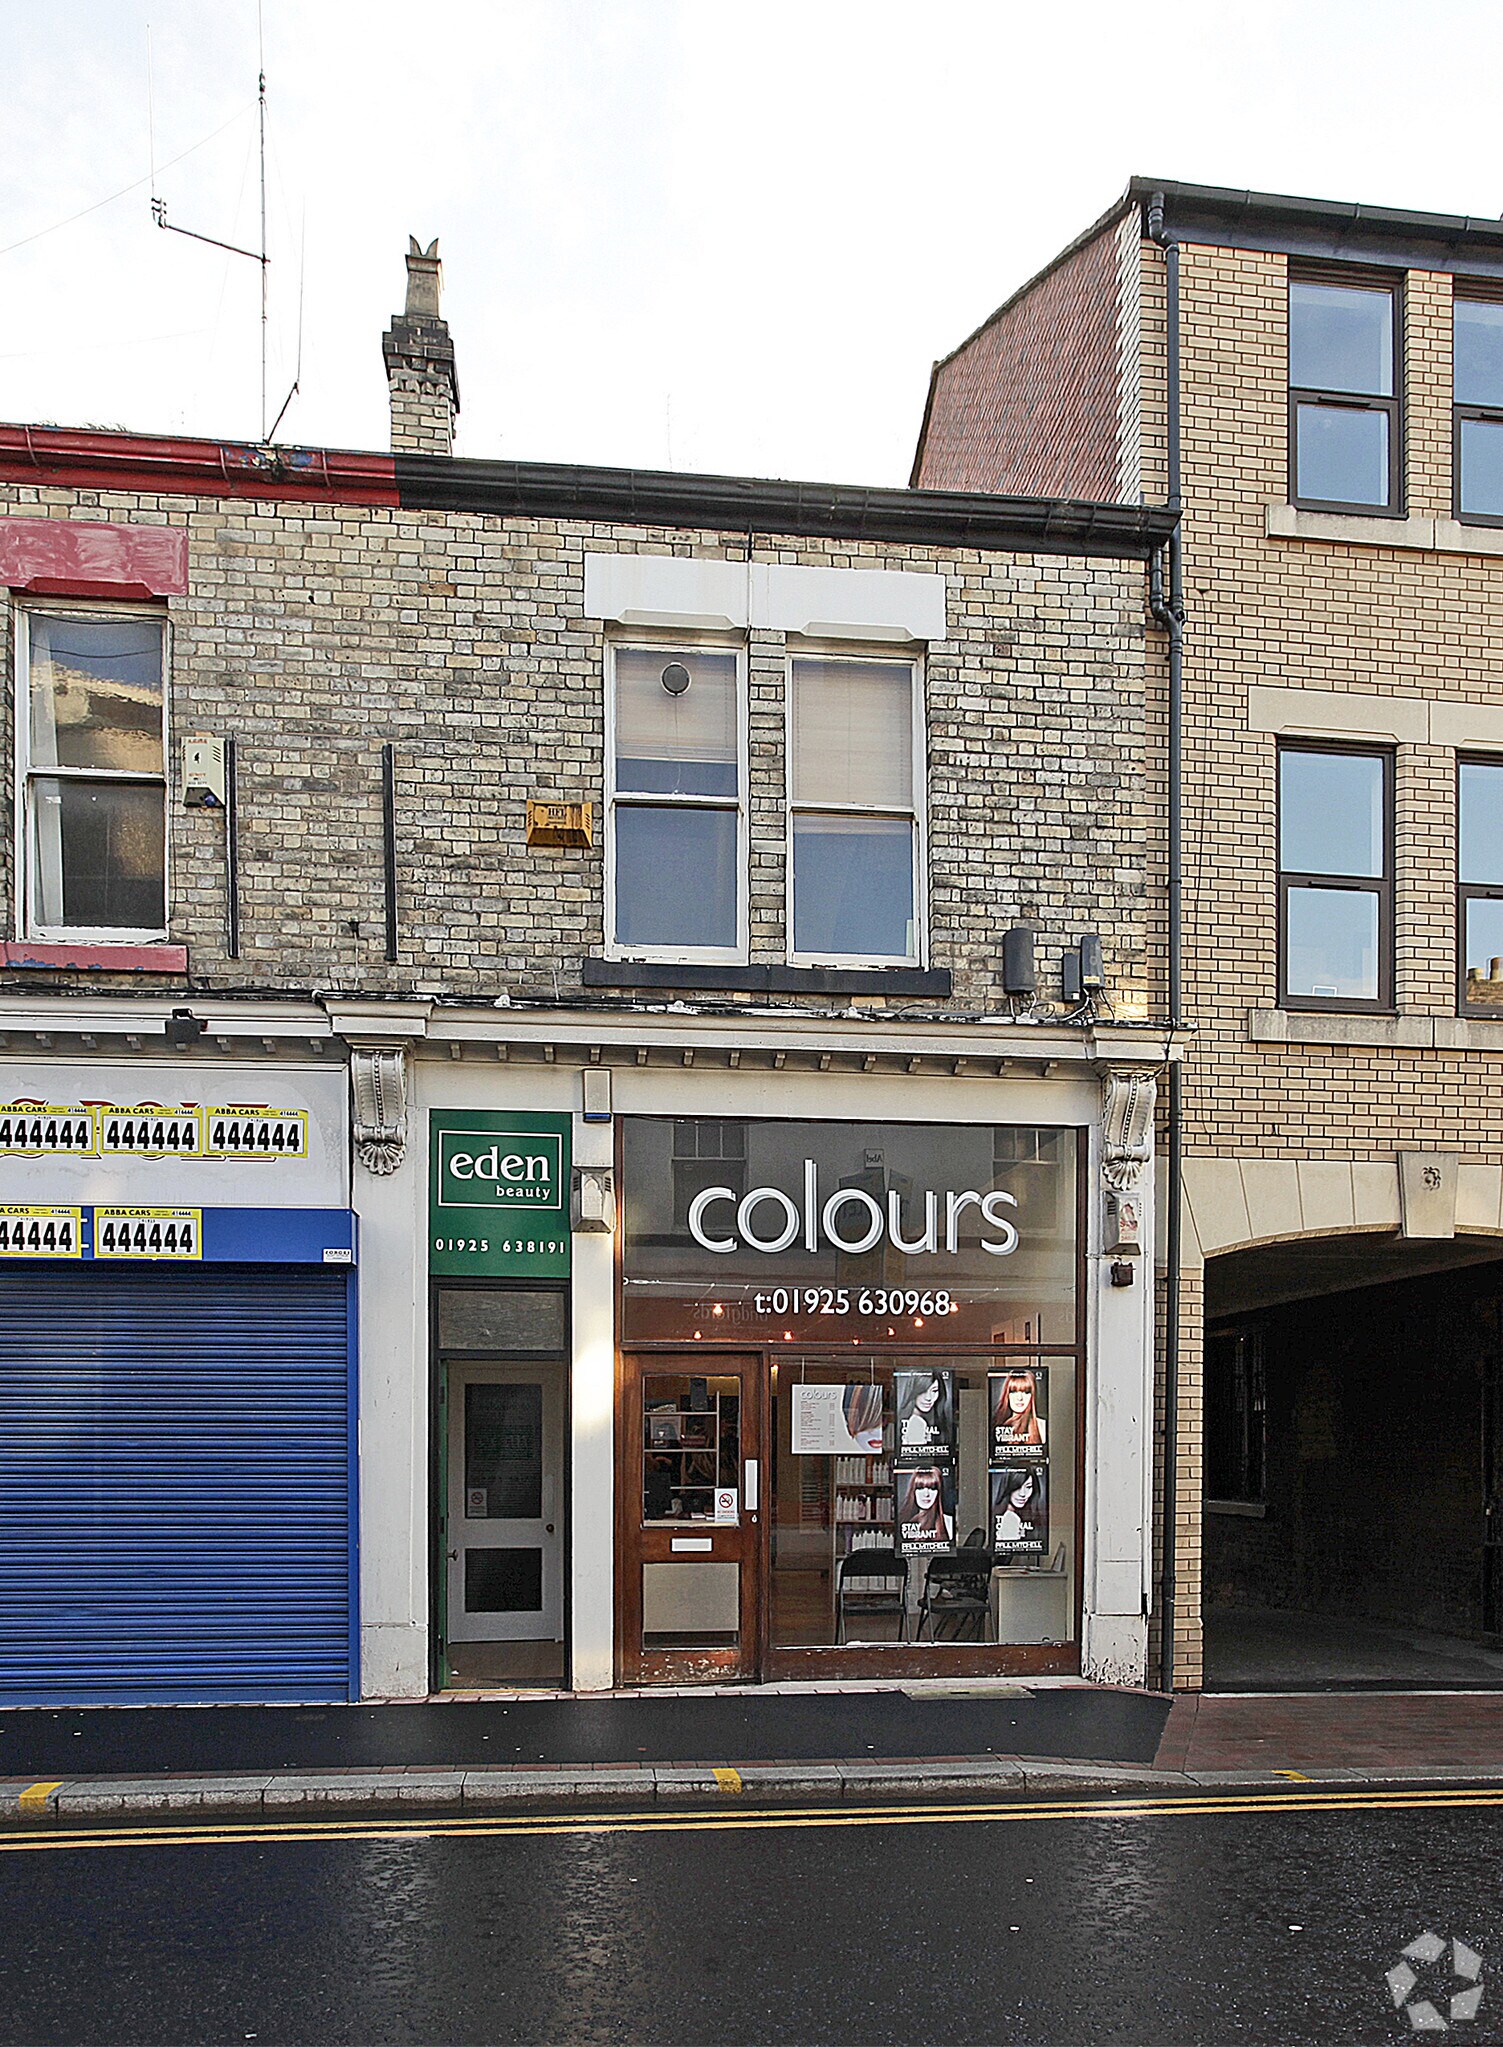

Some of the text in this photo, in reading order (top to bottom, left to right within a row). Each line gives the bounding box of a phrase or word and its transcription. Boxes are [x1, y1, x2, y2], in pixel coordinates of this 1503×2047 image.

[0, 1119, 88, 1148] 444444
[107, 1121, 194, 1150] 444444
[213, 1122, 299, 1151] 444444
[450, 1146, 550, 1181] eden
[496, 1185, 550, 1200] beauty
[688, 1158, 1020, 1256] colours
[103, 1223, 192, 1252] 444444
[435, 1239, 565, 1253] 01925 638191
[754, 1289, 950, 1316] t:01925 630968
[800, 1389, 837, 1400] colours
